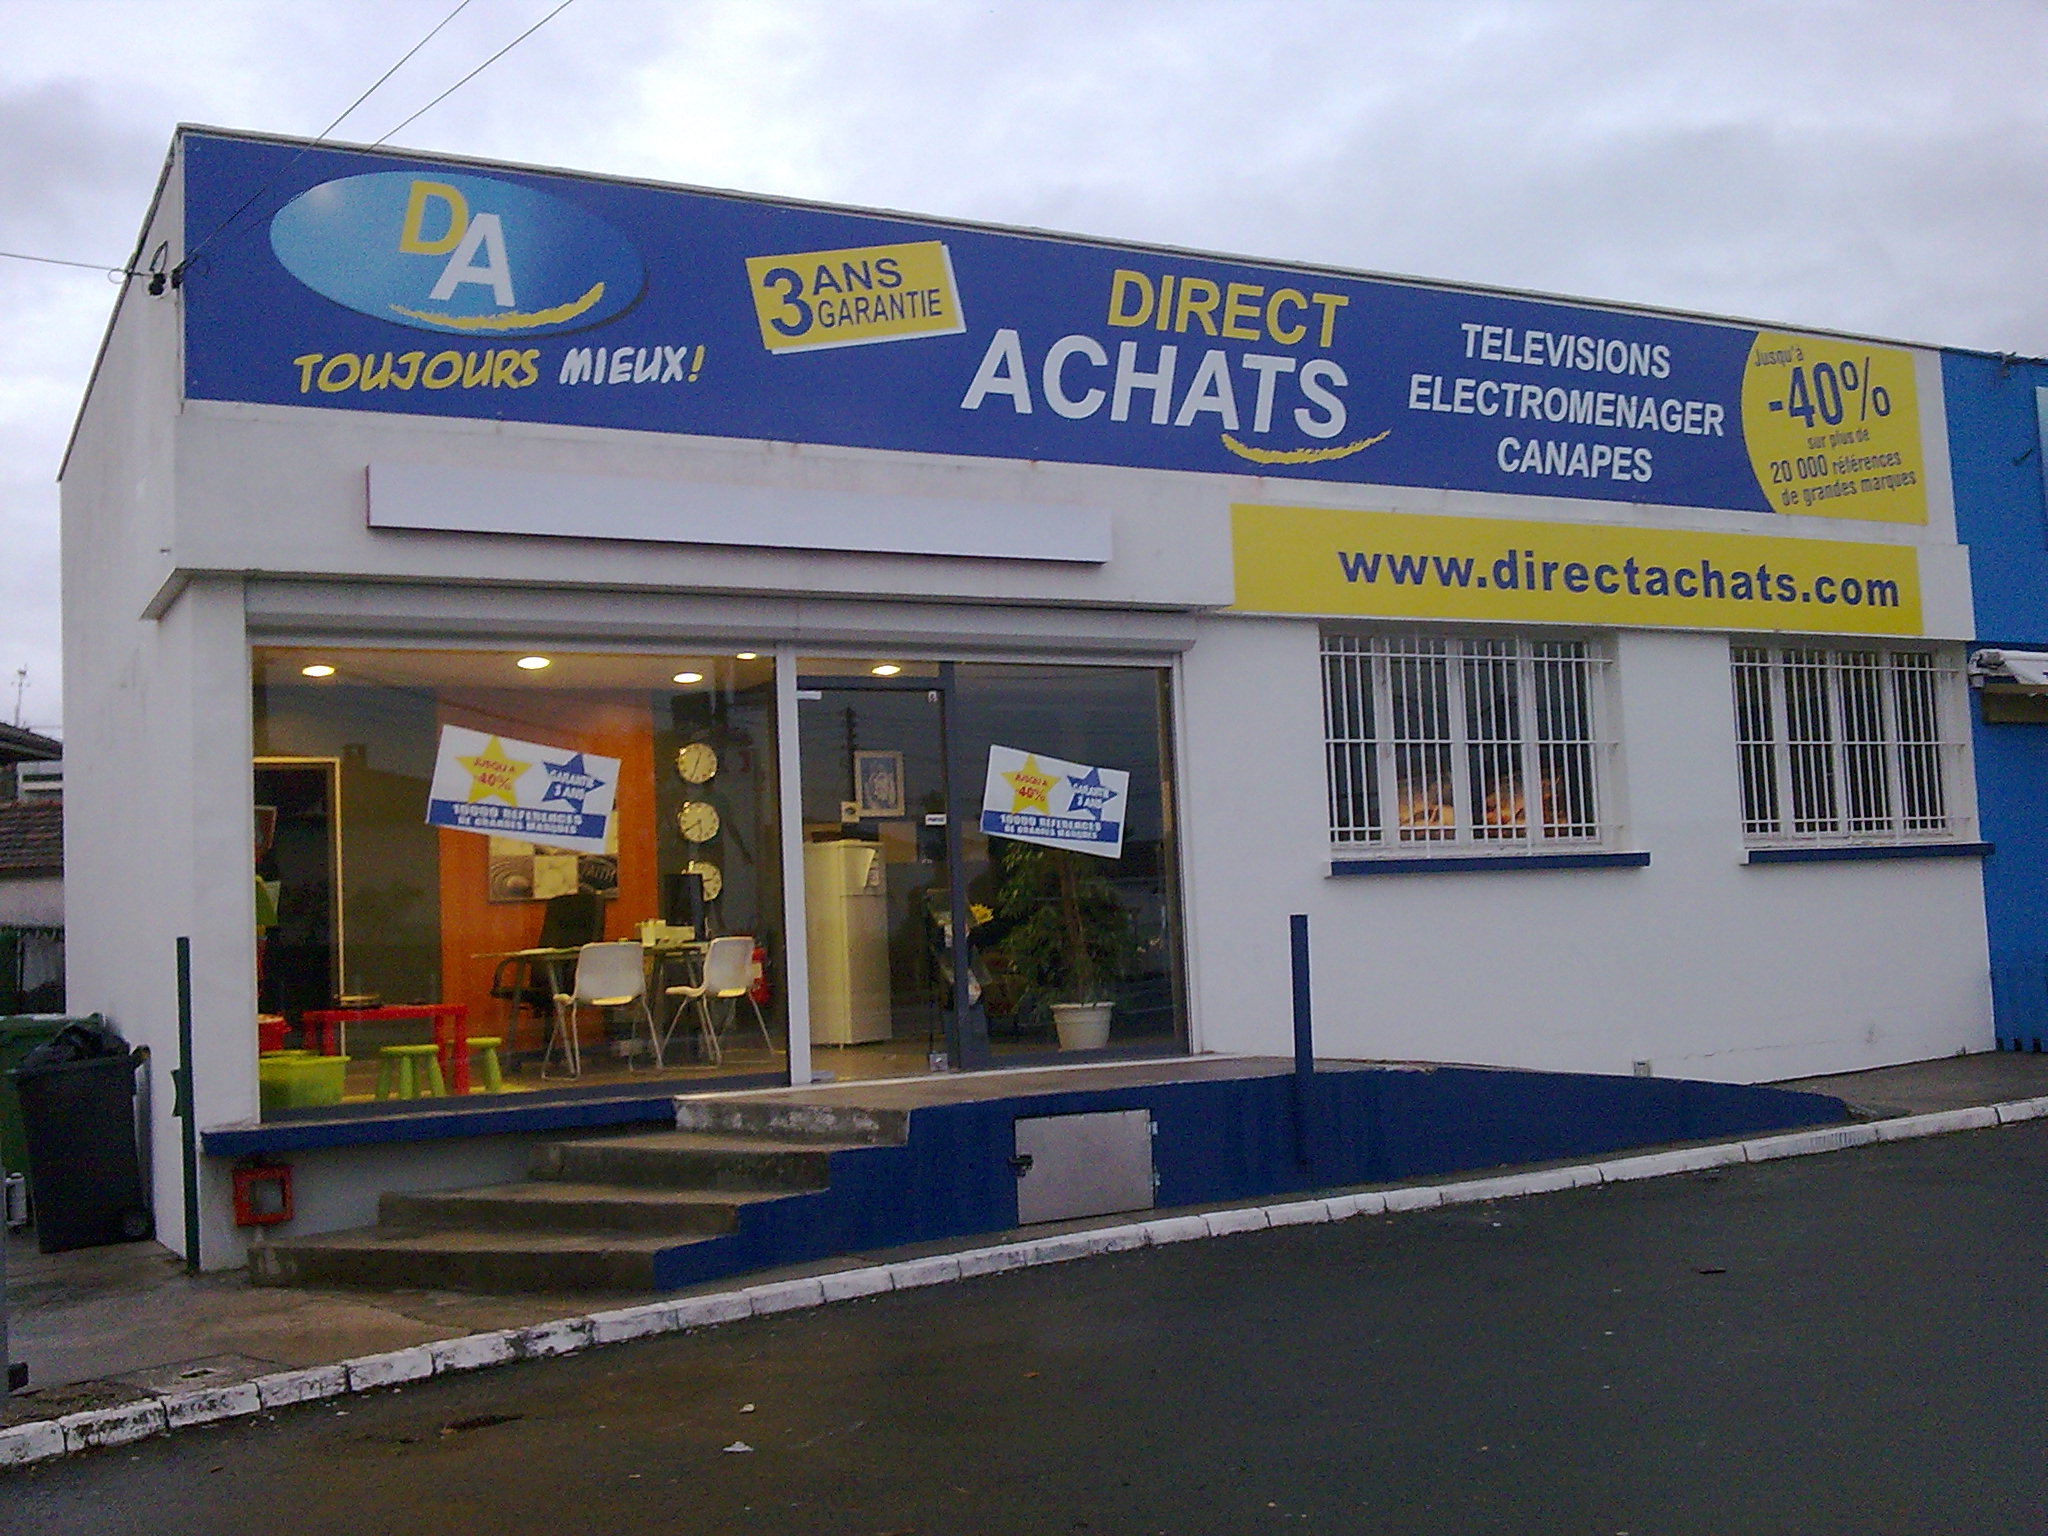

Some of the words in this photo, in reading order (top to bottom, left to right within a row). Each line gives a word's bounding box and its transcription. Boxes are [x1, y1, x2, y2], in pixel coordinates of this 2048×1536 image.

[400, 180, 515, 306] DA
[763, 267, 814, 337] 3
[813, 258, 903, 296] ANS
[818, 289, 942, 328] GARANTIE
[1106, 269, 1349, 348] DIRECT
[293, 349, 540, 393] TOUJOURS
[558, 345, 706, 386] MIEUX!
[1461, 323, 1671, 379] TELEVISIONS
[960, 328, 1349, 439] ACHATS
[1408, 373, 1725, 437] ELECTROMENAGER
[1768, 356, 1891, 428] -40%
[1497, 436, 1653, 482] CANAPES
[1807, 435, 1826, 449] sur
[1830, 431, 1854, 448] plus
[1856, 428, 1870, 442] de
[1770, 460, 1793, 484] 20
[1796, 454, 1828, 480] 000
[1781, 488, 1799, 506] de
[1803, 480, 1857, 506] grandes
[1860, 470, 1918, 492] marques
[1338, 548, 1900, 607] www.directachats.com
